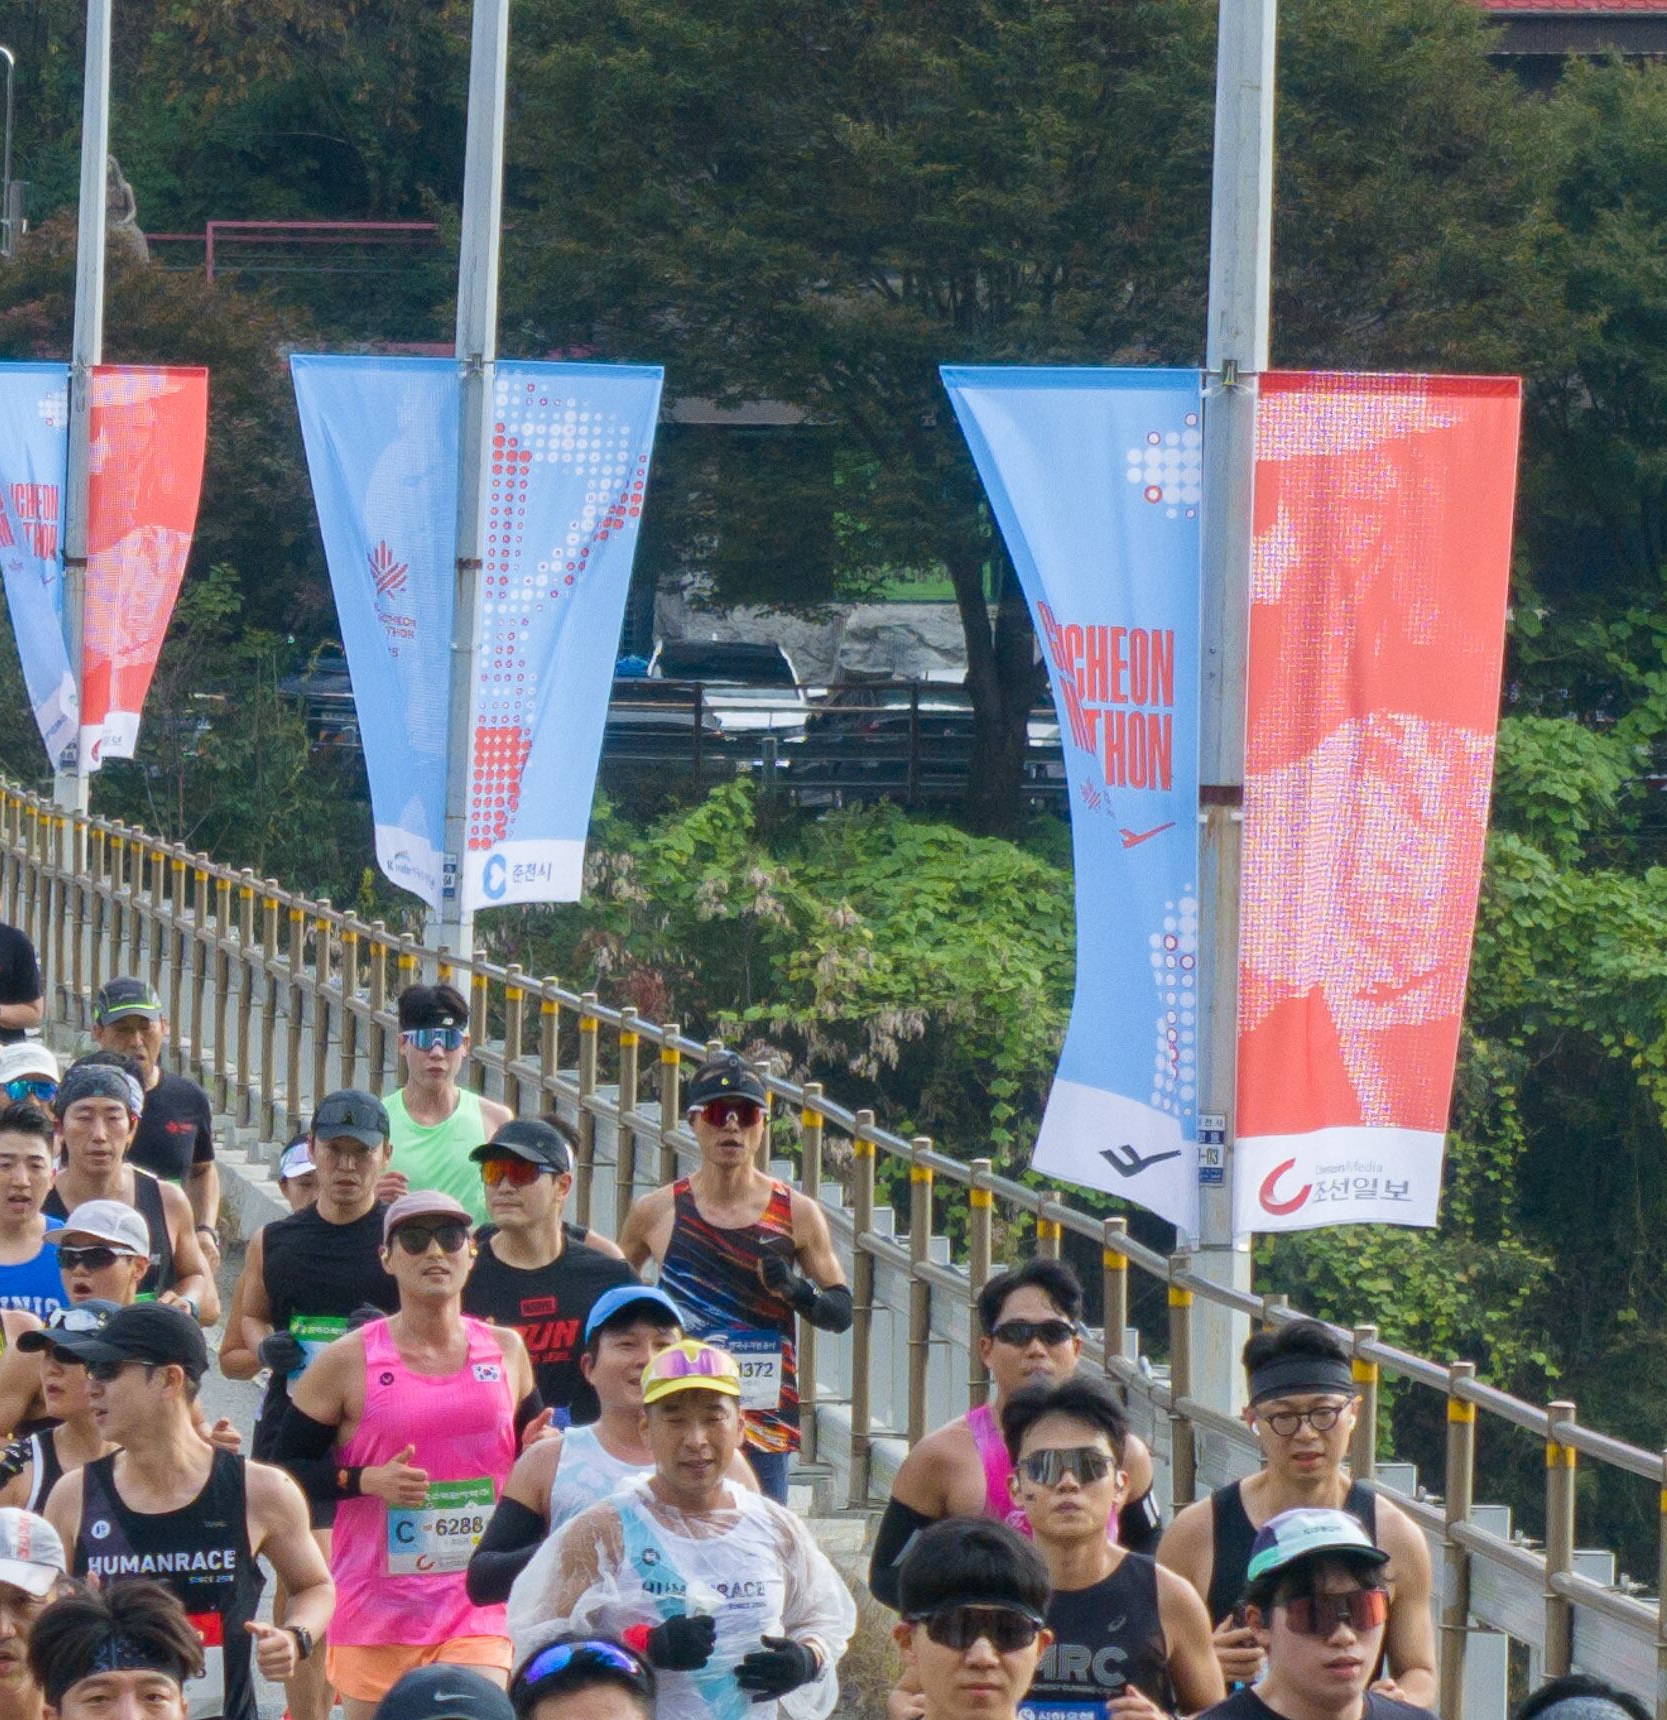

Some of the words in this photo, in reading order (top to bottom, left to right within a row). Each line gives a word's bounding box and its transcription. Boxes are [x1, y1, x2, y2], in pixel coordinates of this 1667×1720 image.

[1047, 612, 1175, 706] CHEON
[1312, 1175, 1414, 1204] 조선일보
[397, 1520, 414, 1545] C
[435, 1513, 484, 1535] 6288
[88, 1549, 237, 1576] HUMANRACE
